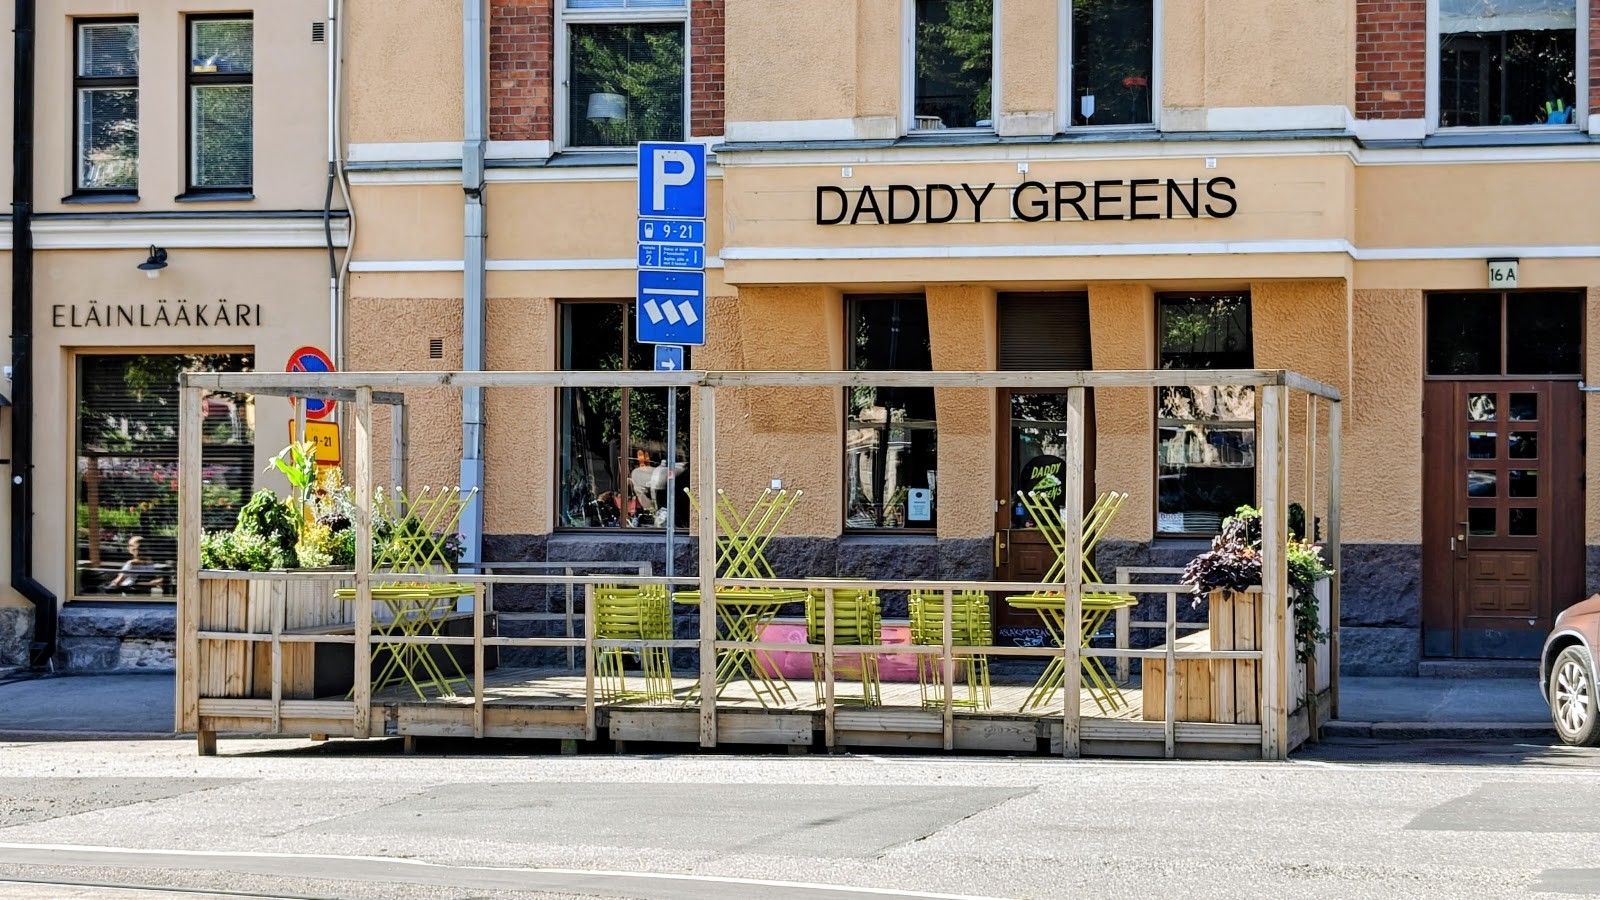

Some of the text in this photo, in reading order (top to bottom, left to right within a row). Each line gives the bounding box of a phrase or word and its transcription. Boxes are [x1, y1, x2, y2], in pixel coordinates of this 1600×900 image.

[652, 149, 696, 211] P
[816, 176, 1238, 225] DADDY GREENS
[645, 254, 652, 266] 2
[1490, 268, 1516, 281] 16 A
[52, 299, 262, 327] ELÄINLÄÄKÄRI
[1030, 462, 1062, 480] DADDY
